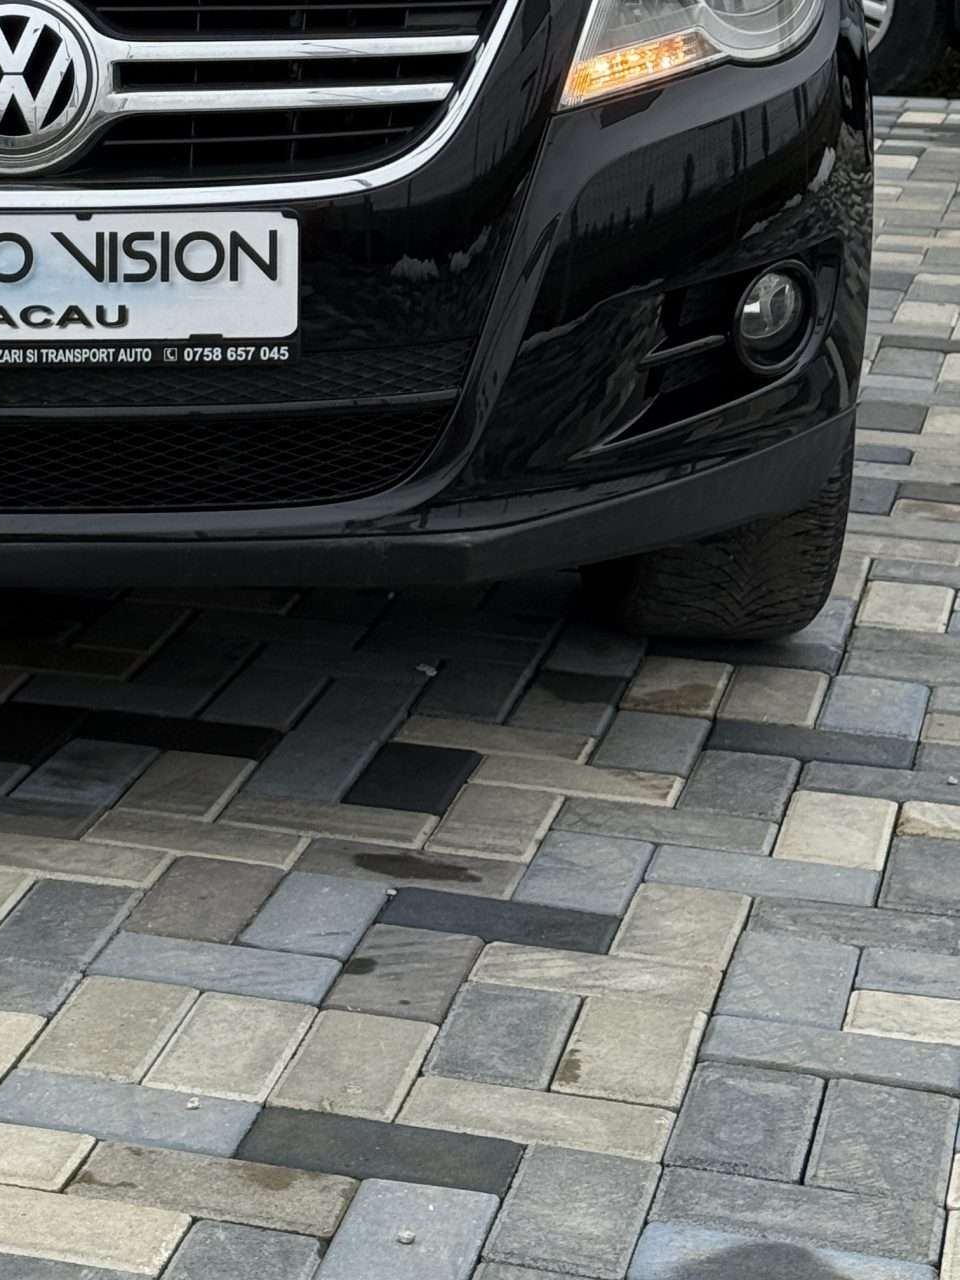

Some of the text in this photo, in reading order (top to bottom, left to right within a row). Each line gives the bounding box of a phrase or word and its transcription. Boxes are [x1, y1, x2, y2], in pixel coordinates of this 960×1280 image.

[50, 229, 278, 283] VISION
[26, 349, 38, 363] SI
[40, 349, 115, 363] TRANSPORT
[118, 348, 152, 362] AUTO
[183, 347, 222, 362] 0758
[227, 347, 255, 361] 657
[260, 346, 289, 361] 045
